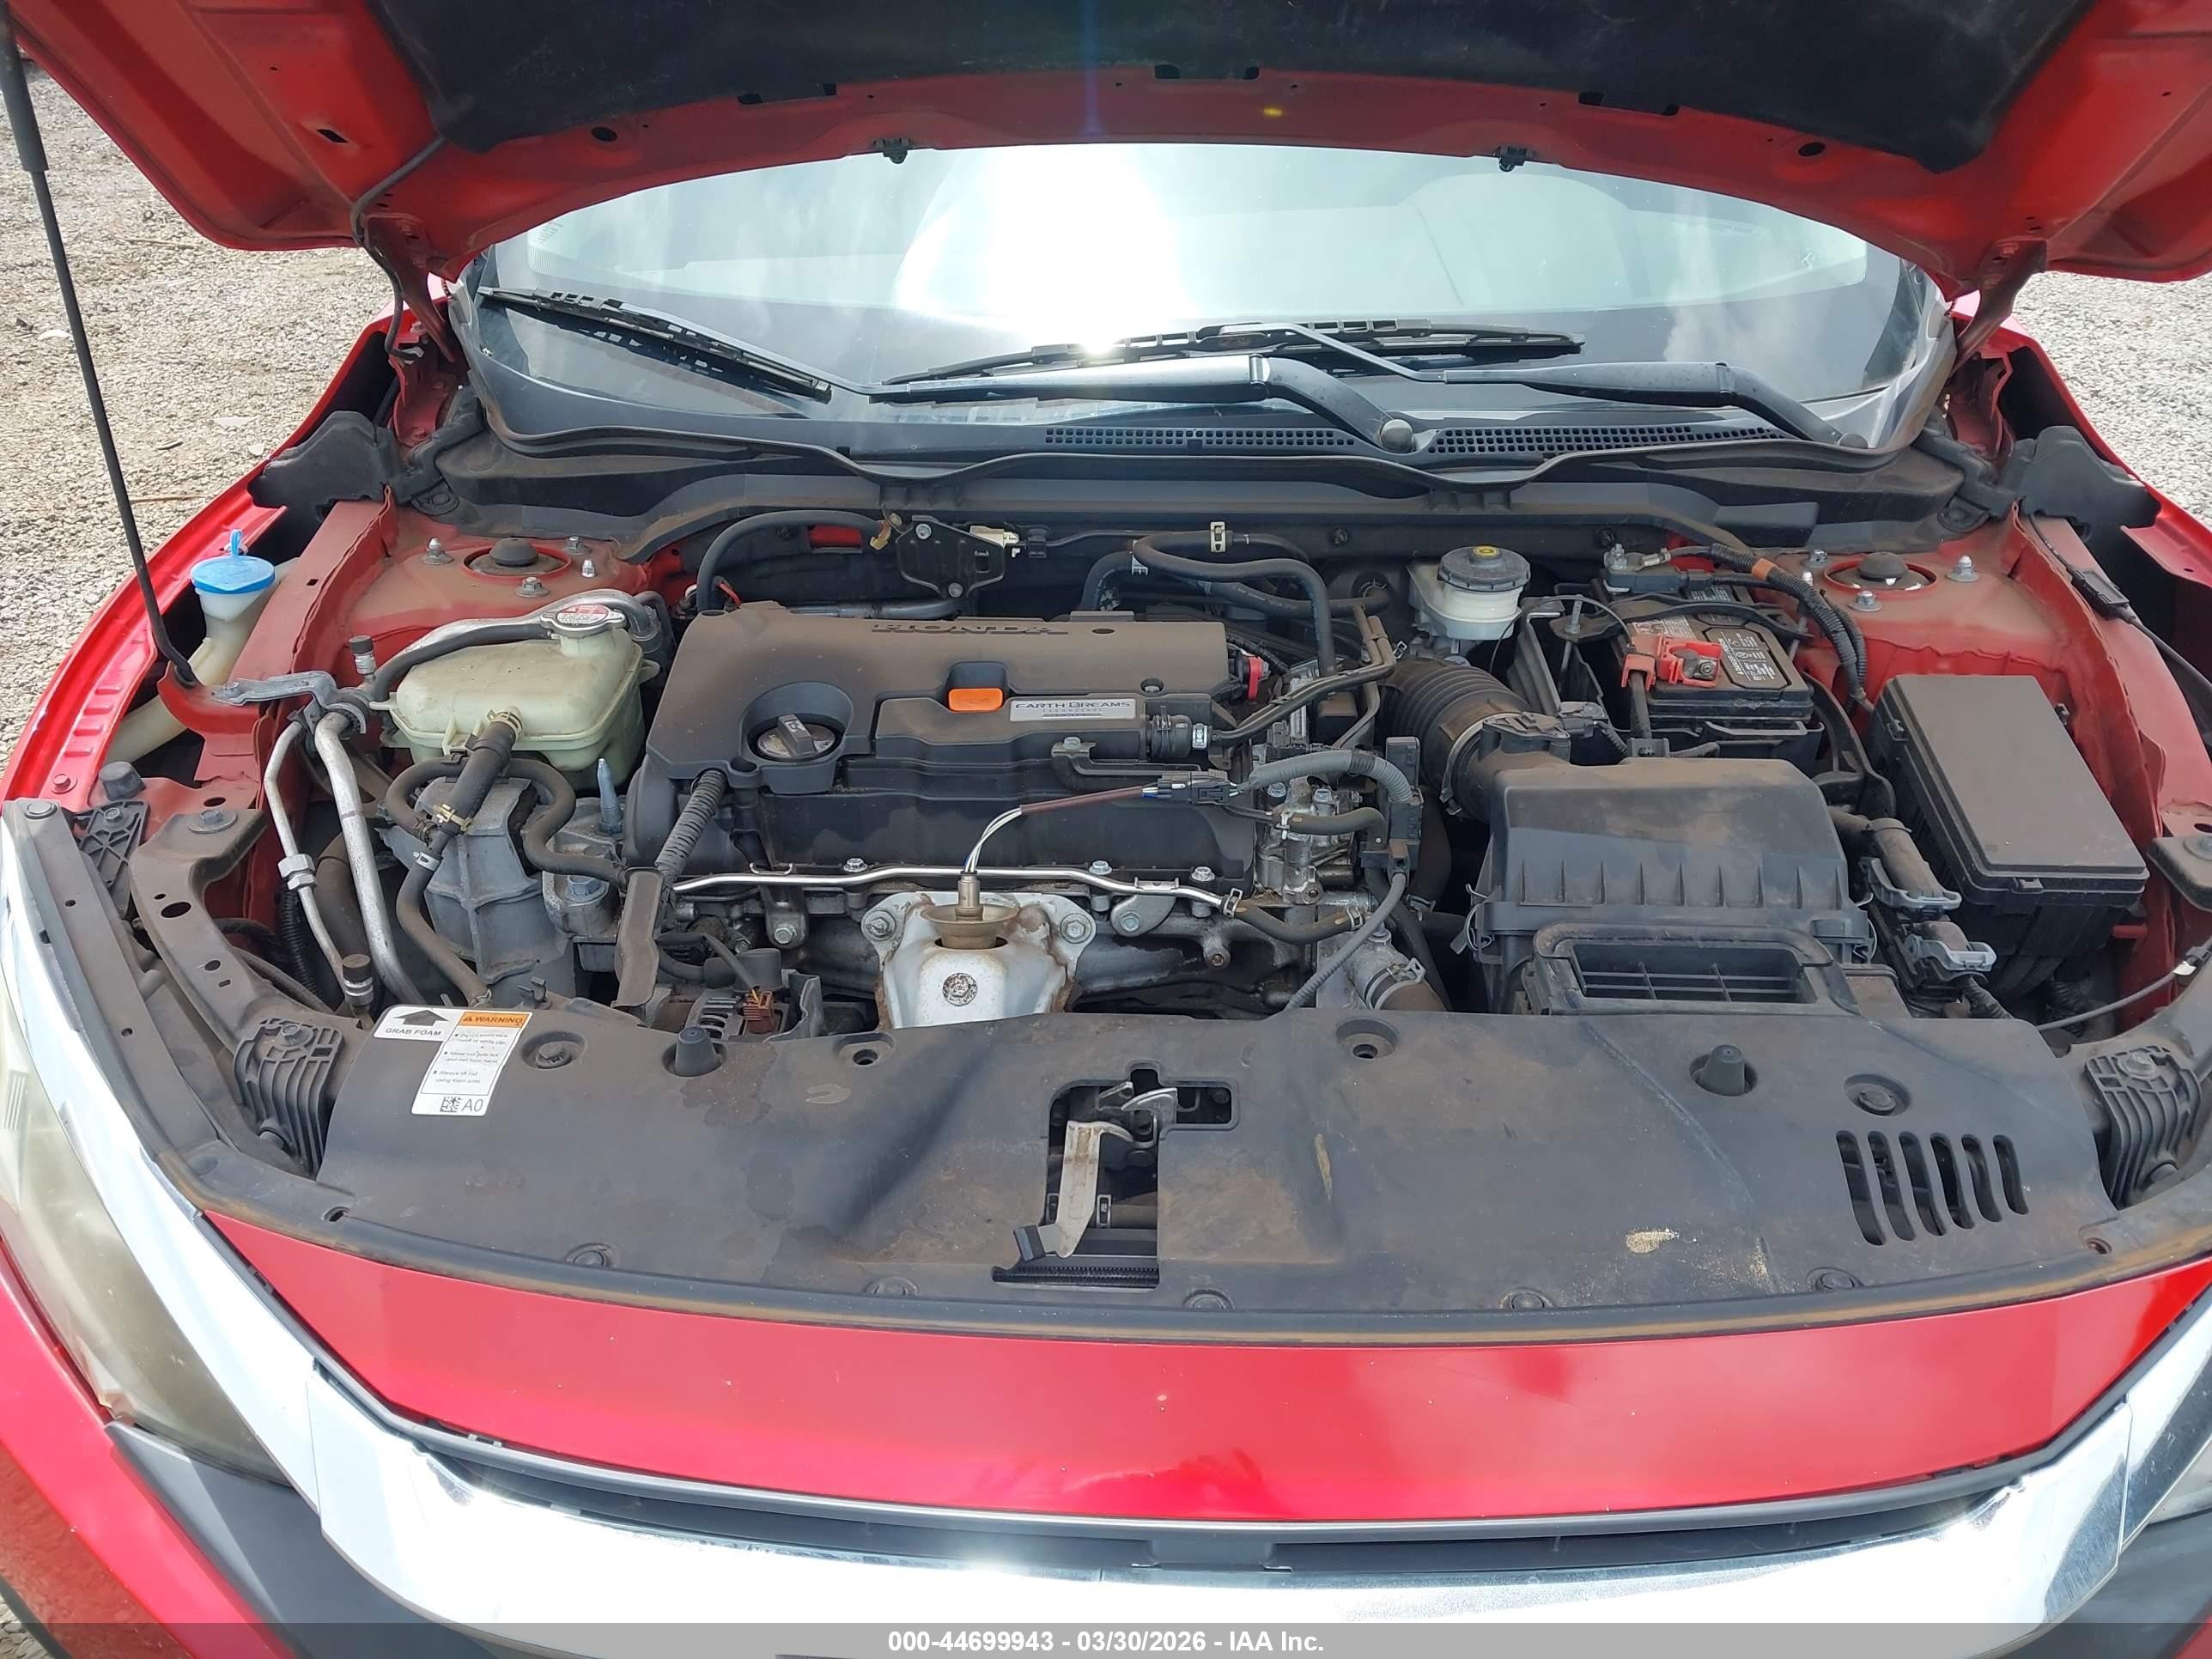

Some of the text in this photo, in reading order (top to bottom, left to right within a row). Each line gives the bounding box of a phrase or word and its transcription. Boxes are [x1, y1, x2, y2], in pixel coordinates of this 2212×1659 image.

[872, 624, 1069, 635] HONDA
[475, 1016, 523, 1025] WARNING
[461, 1098, 484, 1113] A0
